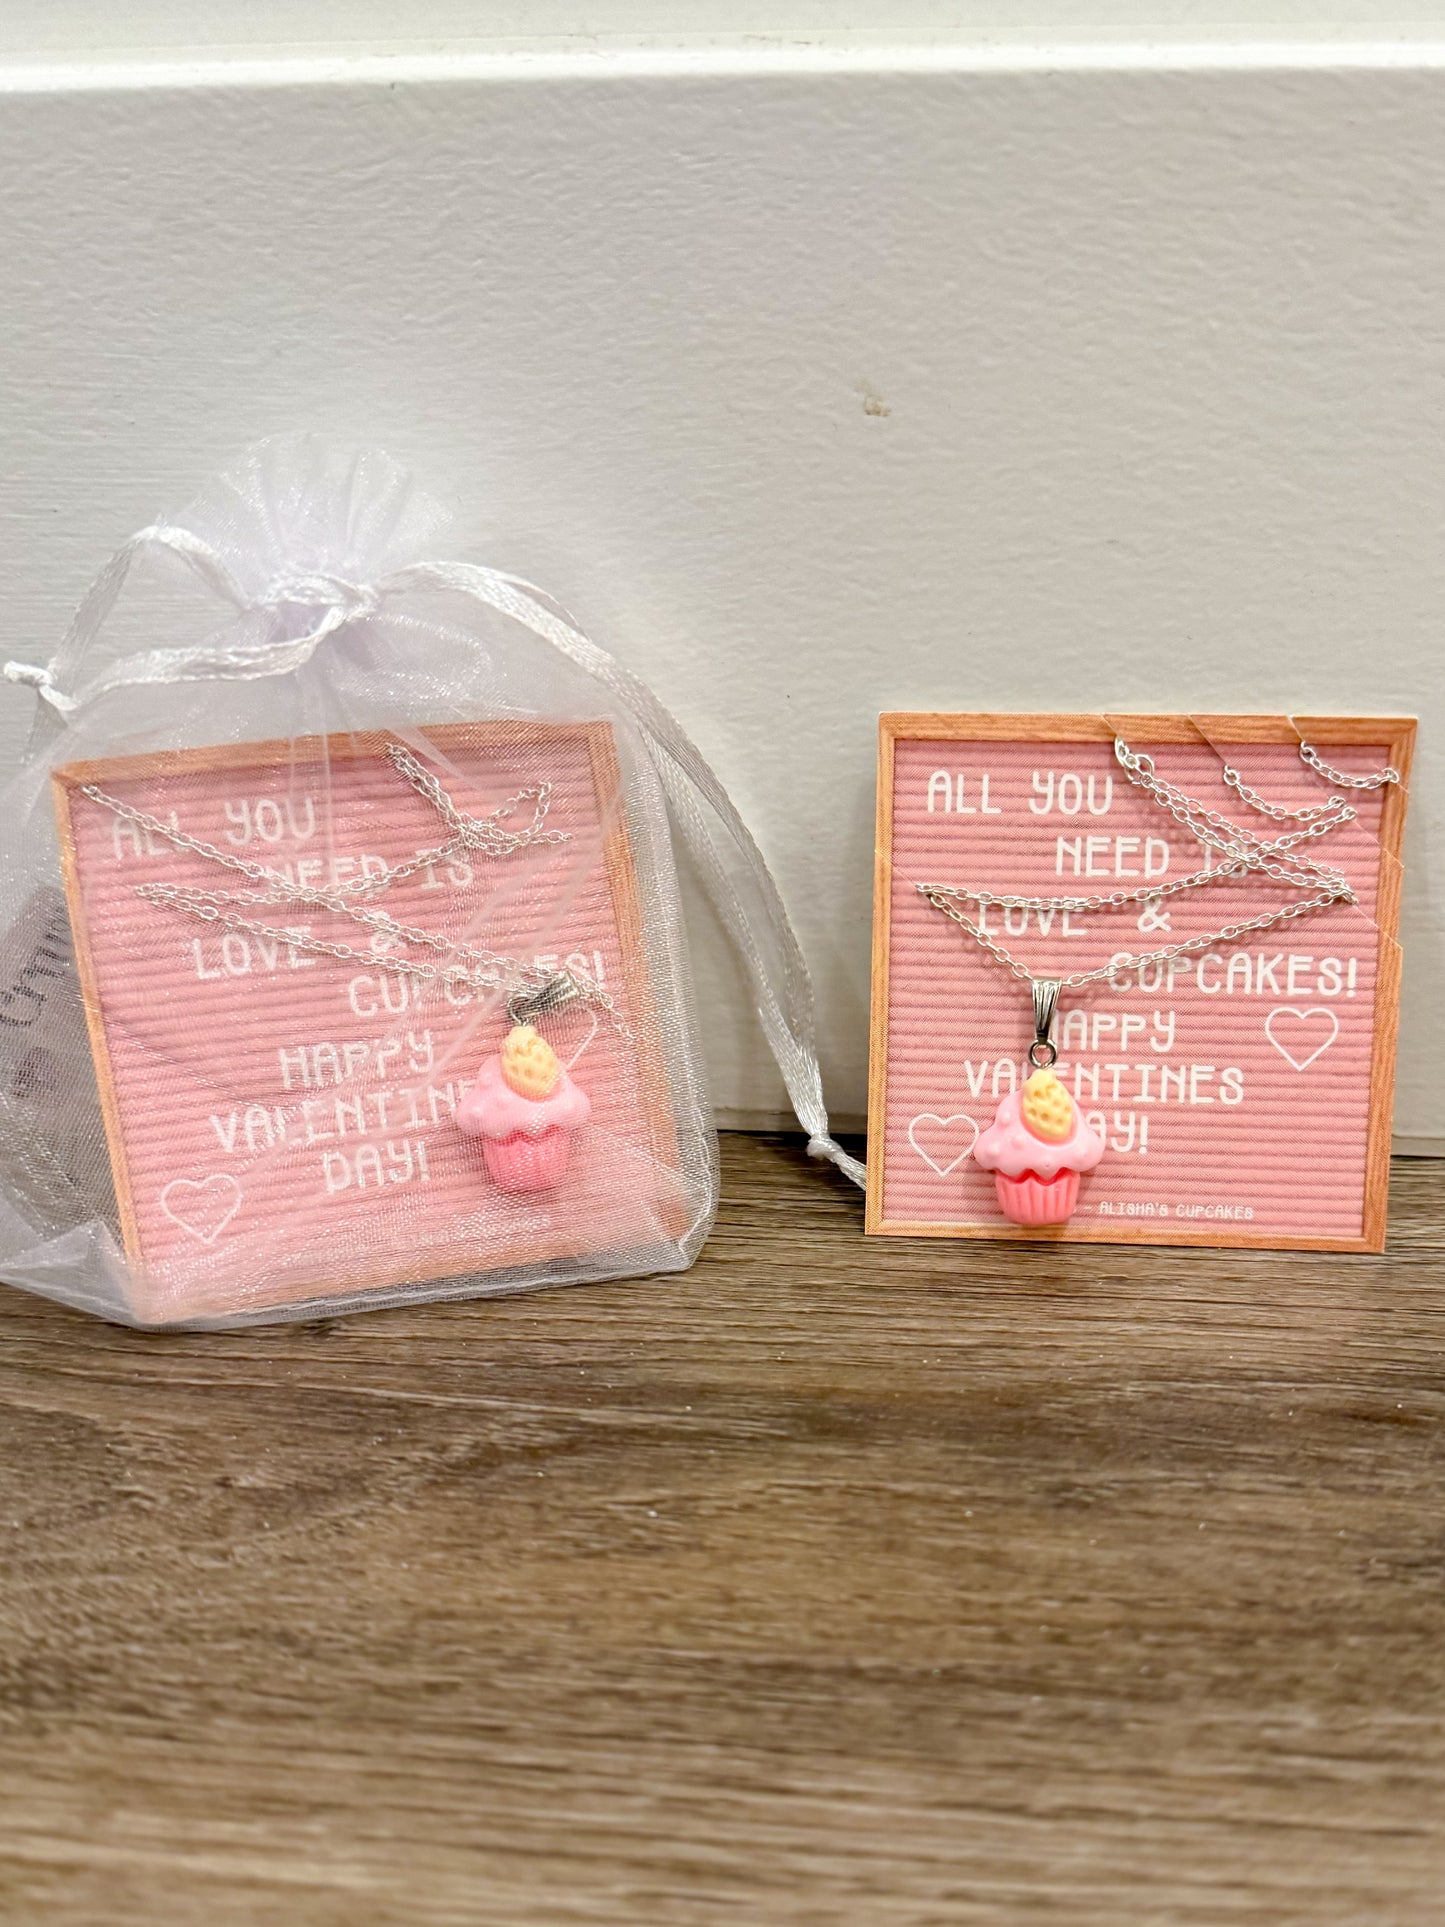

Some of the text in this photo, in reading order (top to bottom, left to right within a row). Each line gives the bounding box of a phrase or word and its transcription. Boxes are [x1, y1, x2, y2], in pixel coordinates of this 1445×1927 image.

[926, 770, 1114, 816] ALL YOU
[223, 797, 316, 846] YOU
[416, 847, 474, 890] IS
[1055, 836, 1170, 878] NEED
[978, 894, 1172, 937] LOVE &
[193, 925, 317, 980] LOVE
[1108, 952, 1357, 998] CUPCAKES!
[1052, 1009, 1176, 1053] APPY
[279, 1029, 434, 1089] HAPPY
[1086, 1110, 1149, 1155] AY!
[320, 1139, 431, 1195] DAY!
[1099, 1201, 1169, 1218] ALISHA'S
[1175, 1204, 1254, 1221] CUPCAKES
